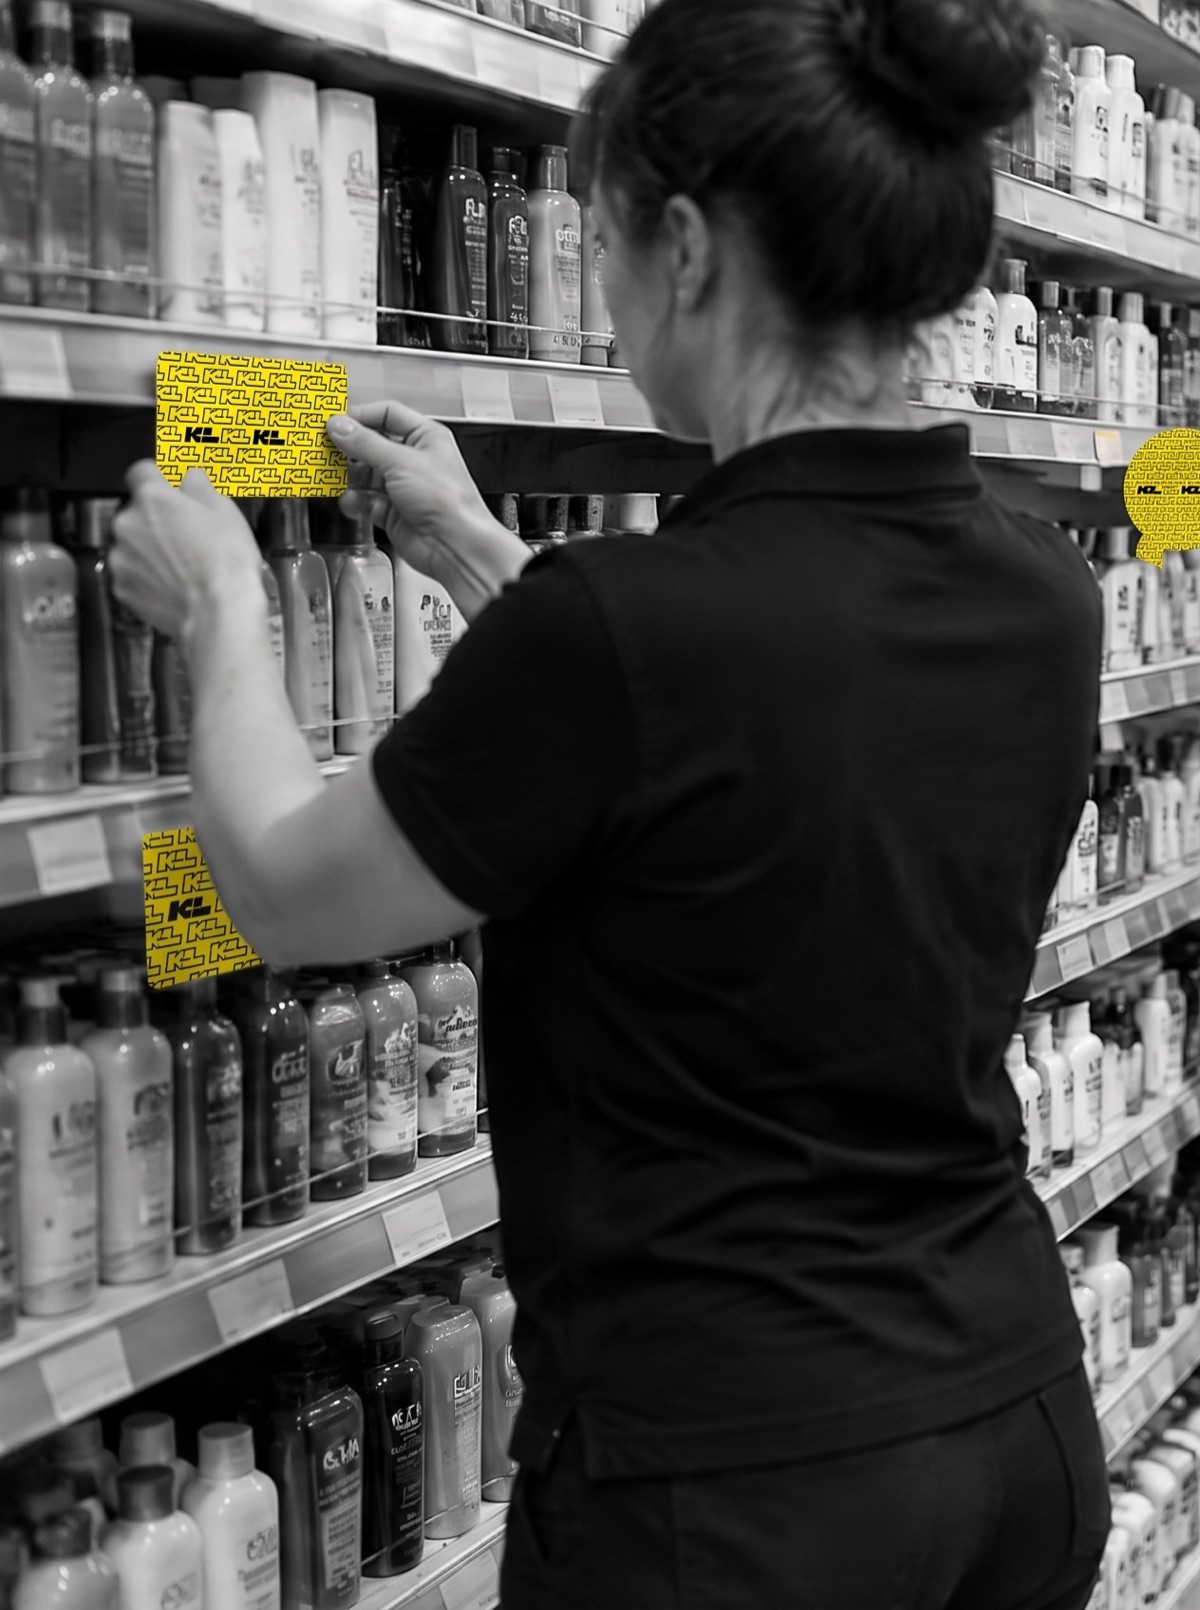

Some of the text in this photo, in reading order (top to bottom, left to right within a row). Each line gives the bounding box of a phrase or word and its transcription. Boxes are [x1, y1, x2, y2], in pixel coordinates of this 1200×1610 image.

[184, 427, 220, 443] KL
[252, 429, 285, 446] KL
[168, 897, 211, 922] KL
